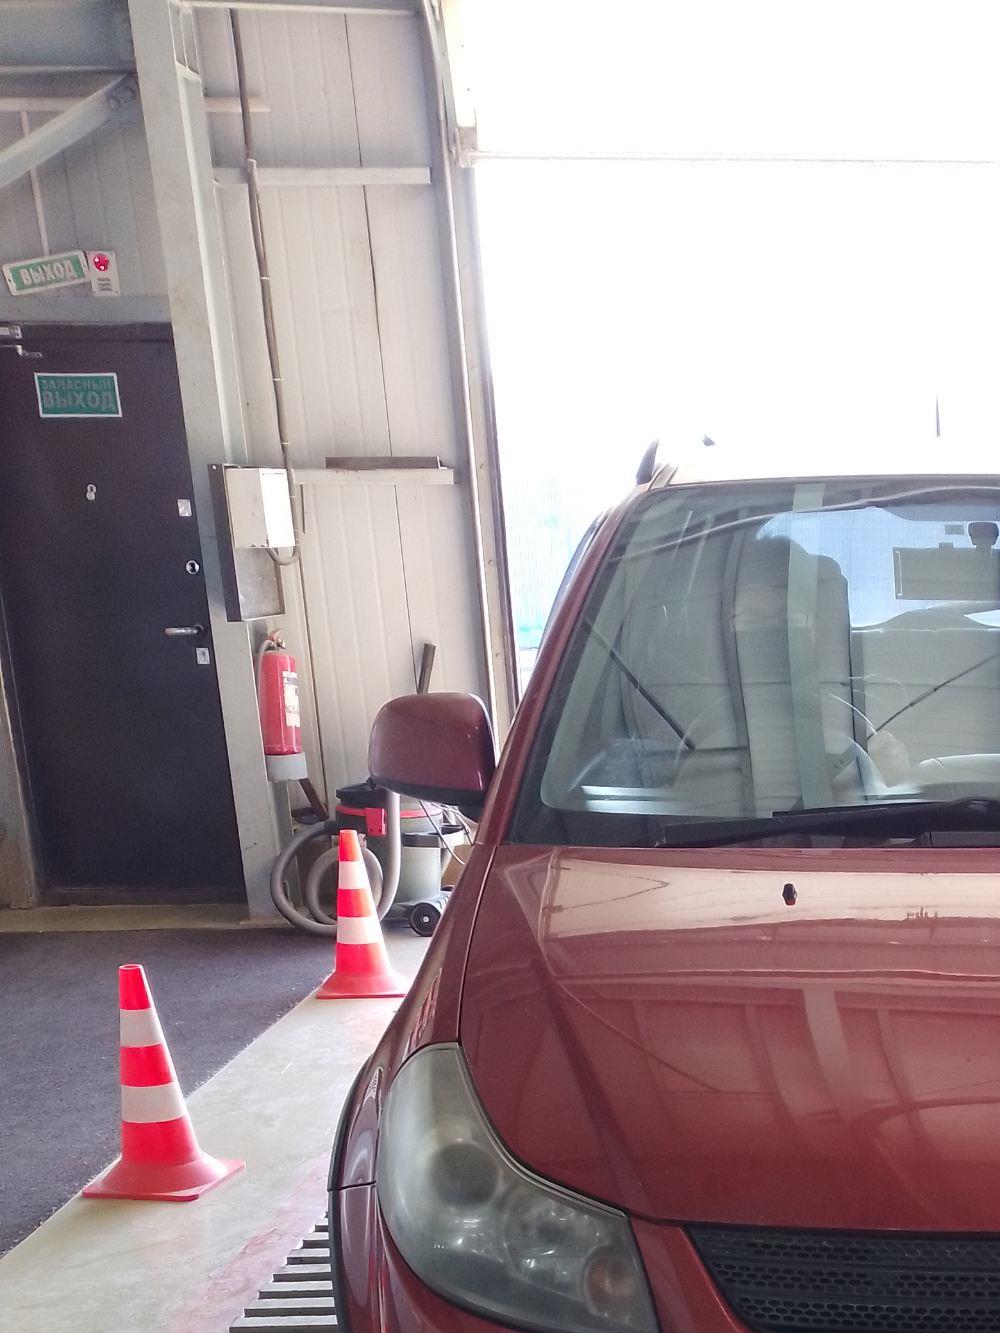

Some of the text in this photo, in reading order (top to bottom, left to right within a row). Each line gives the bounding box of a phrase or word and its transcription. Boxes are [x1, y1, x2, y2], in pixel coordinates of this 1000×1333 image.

[20, 259, 79, 285] ВЫХОД
[41, 378, 112, 390] ЗАПАСНЫЙ
[43, 391, 115, 411] ВЫХОД
